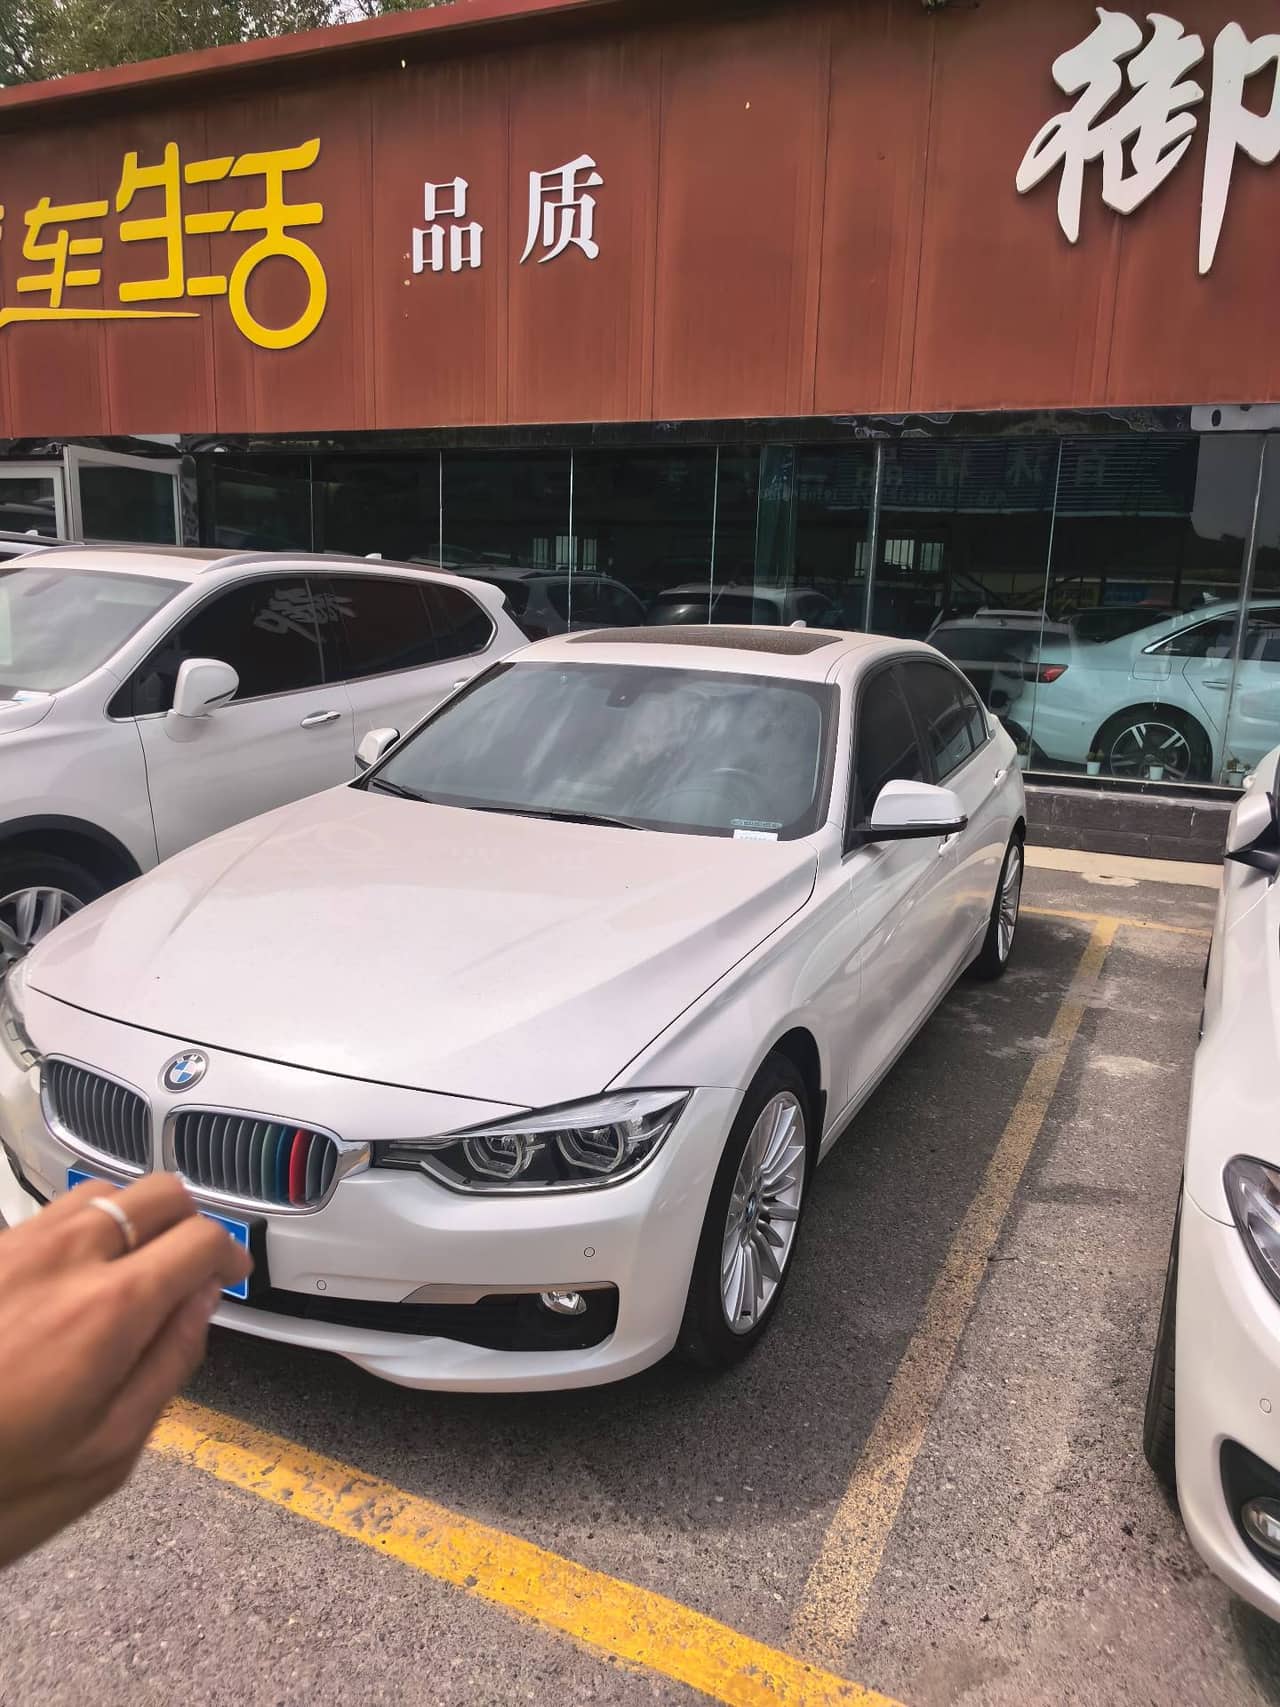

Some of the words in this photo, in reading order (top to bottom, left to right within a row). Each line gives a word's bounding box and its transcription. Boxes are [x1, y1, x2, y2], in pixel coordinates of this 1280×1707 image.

[0, 137, 328, 350] 车生活
[411, 153, 604, 275] 品质
